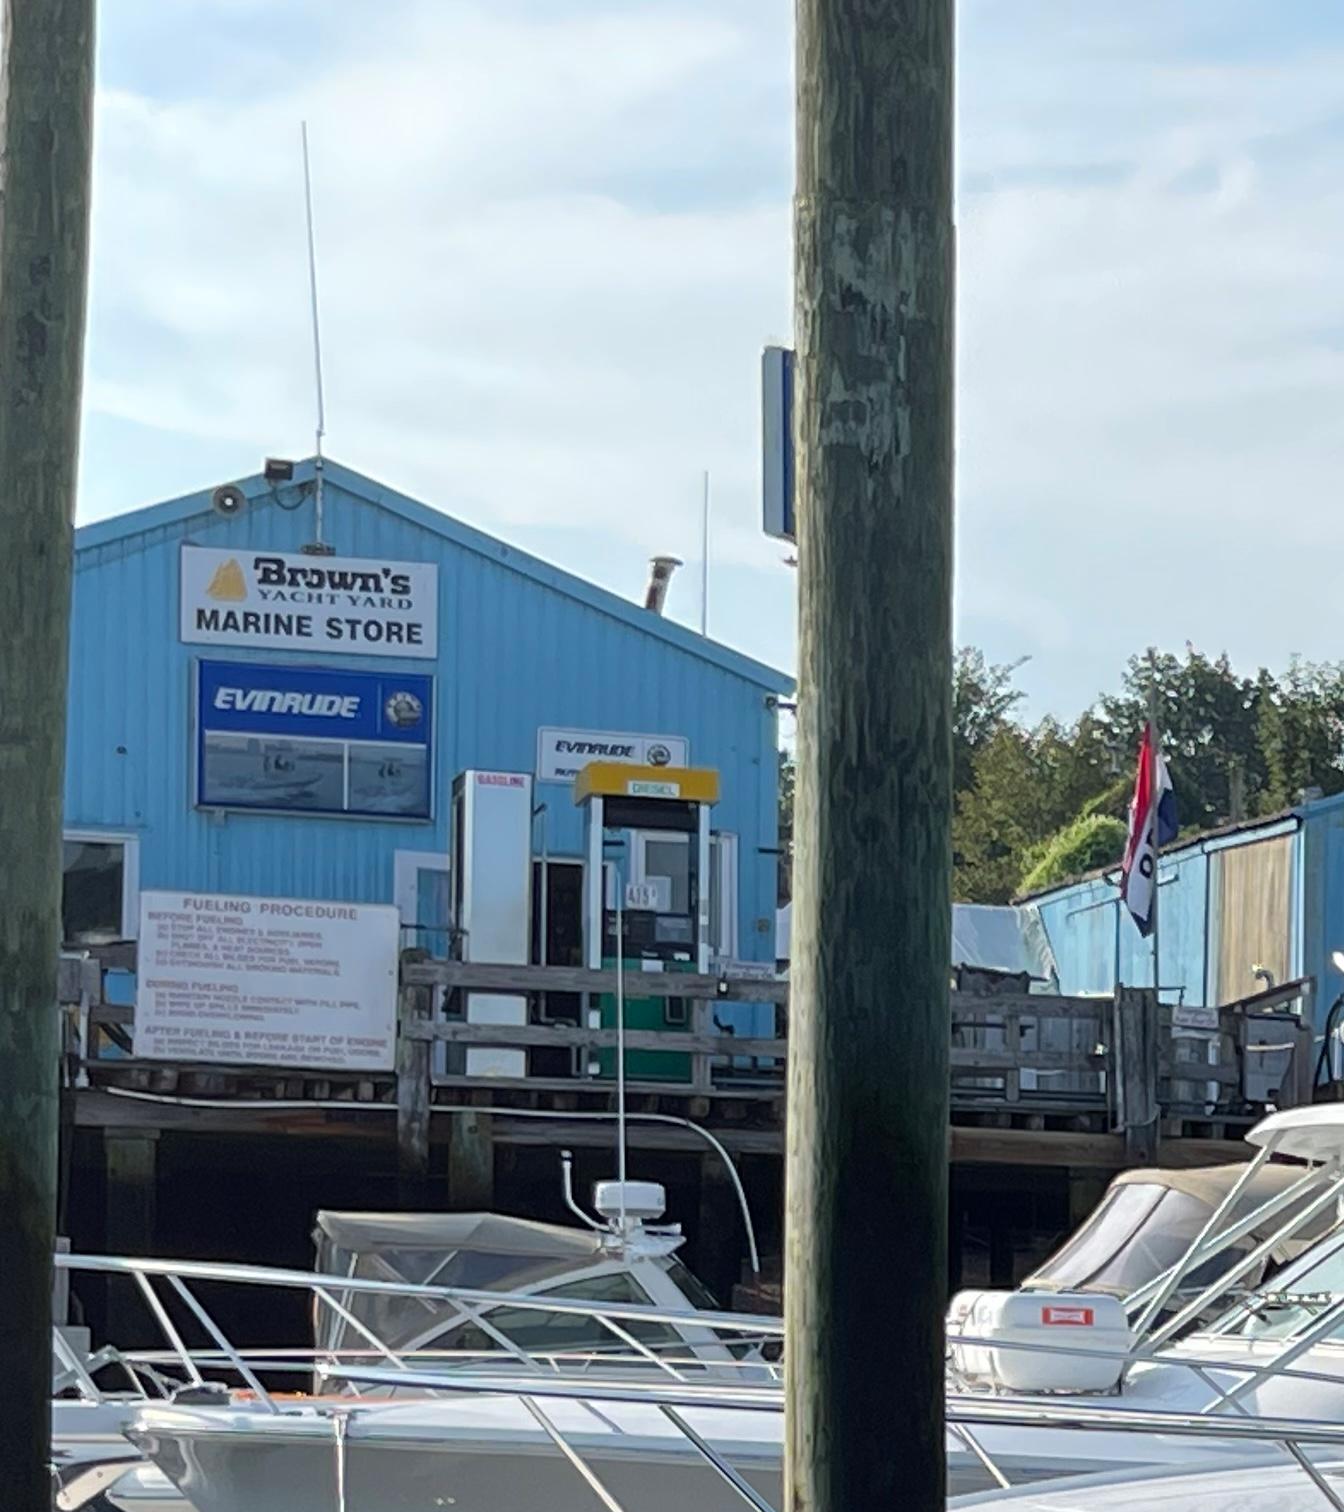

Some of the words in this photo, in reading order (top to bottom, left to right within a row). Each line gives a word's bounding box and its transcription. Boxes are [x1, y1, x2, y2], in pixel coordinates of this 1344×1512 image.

[254, 556, 412, 596] Brown's
[257, 589, 338, 605] YACHT
[346, 595, 413, 611] YARD
[195, 608, 314, 638] MARINE
[325, 616, 424, 645] STORE
[213, 686, 361, 719] EVINRUDE
[554, 739, 636, 759] EVINRUDE
[631, 783, 676, 796] DIESEL
[183, 898, 251, 914] FUELING
[260, 903, 358, 920] PROCEDURE
